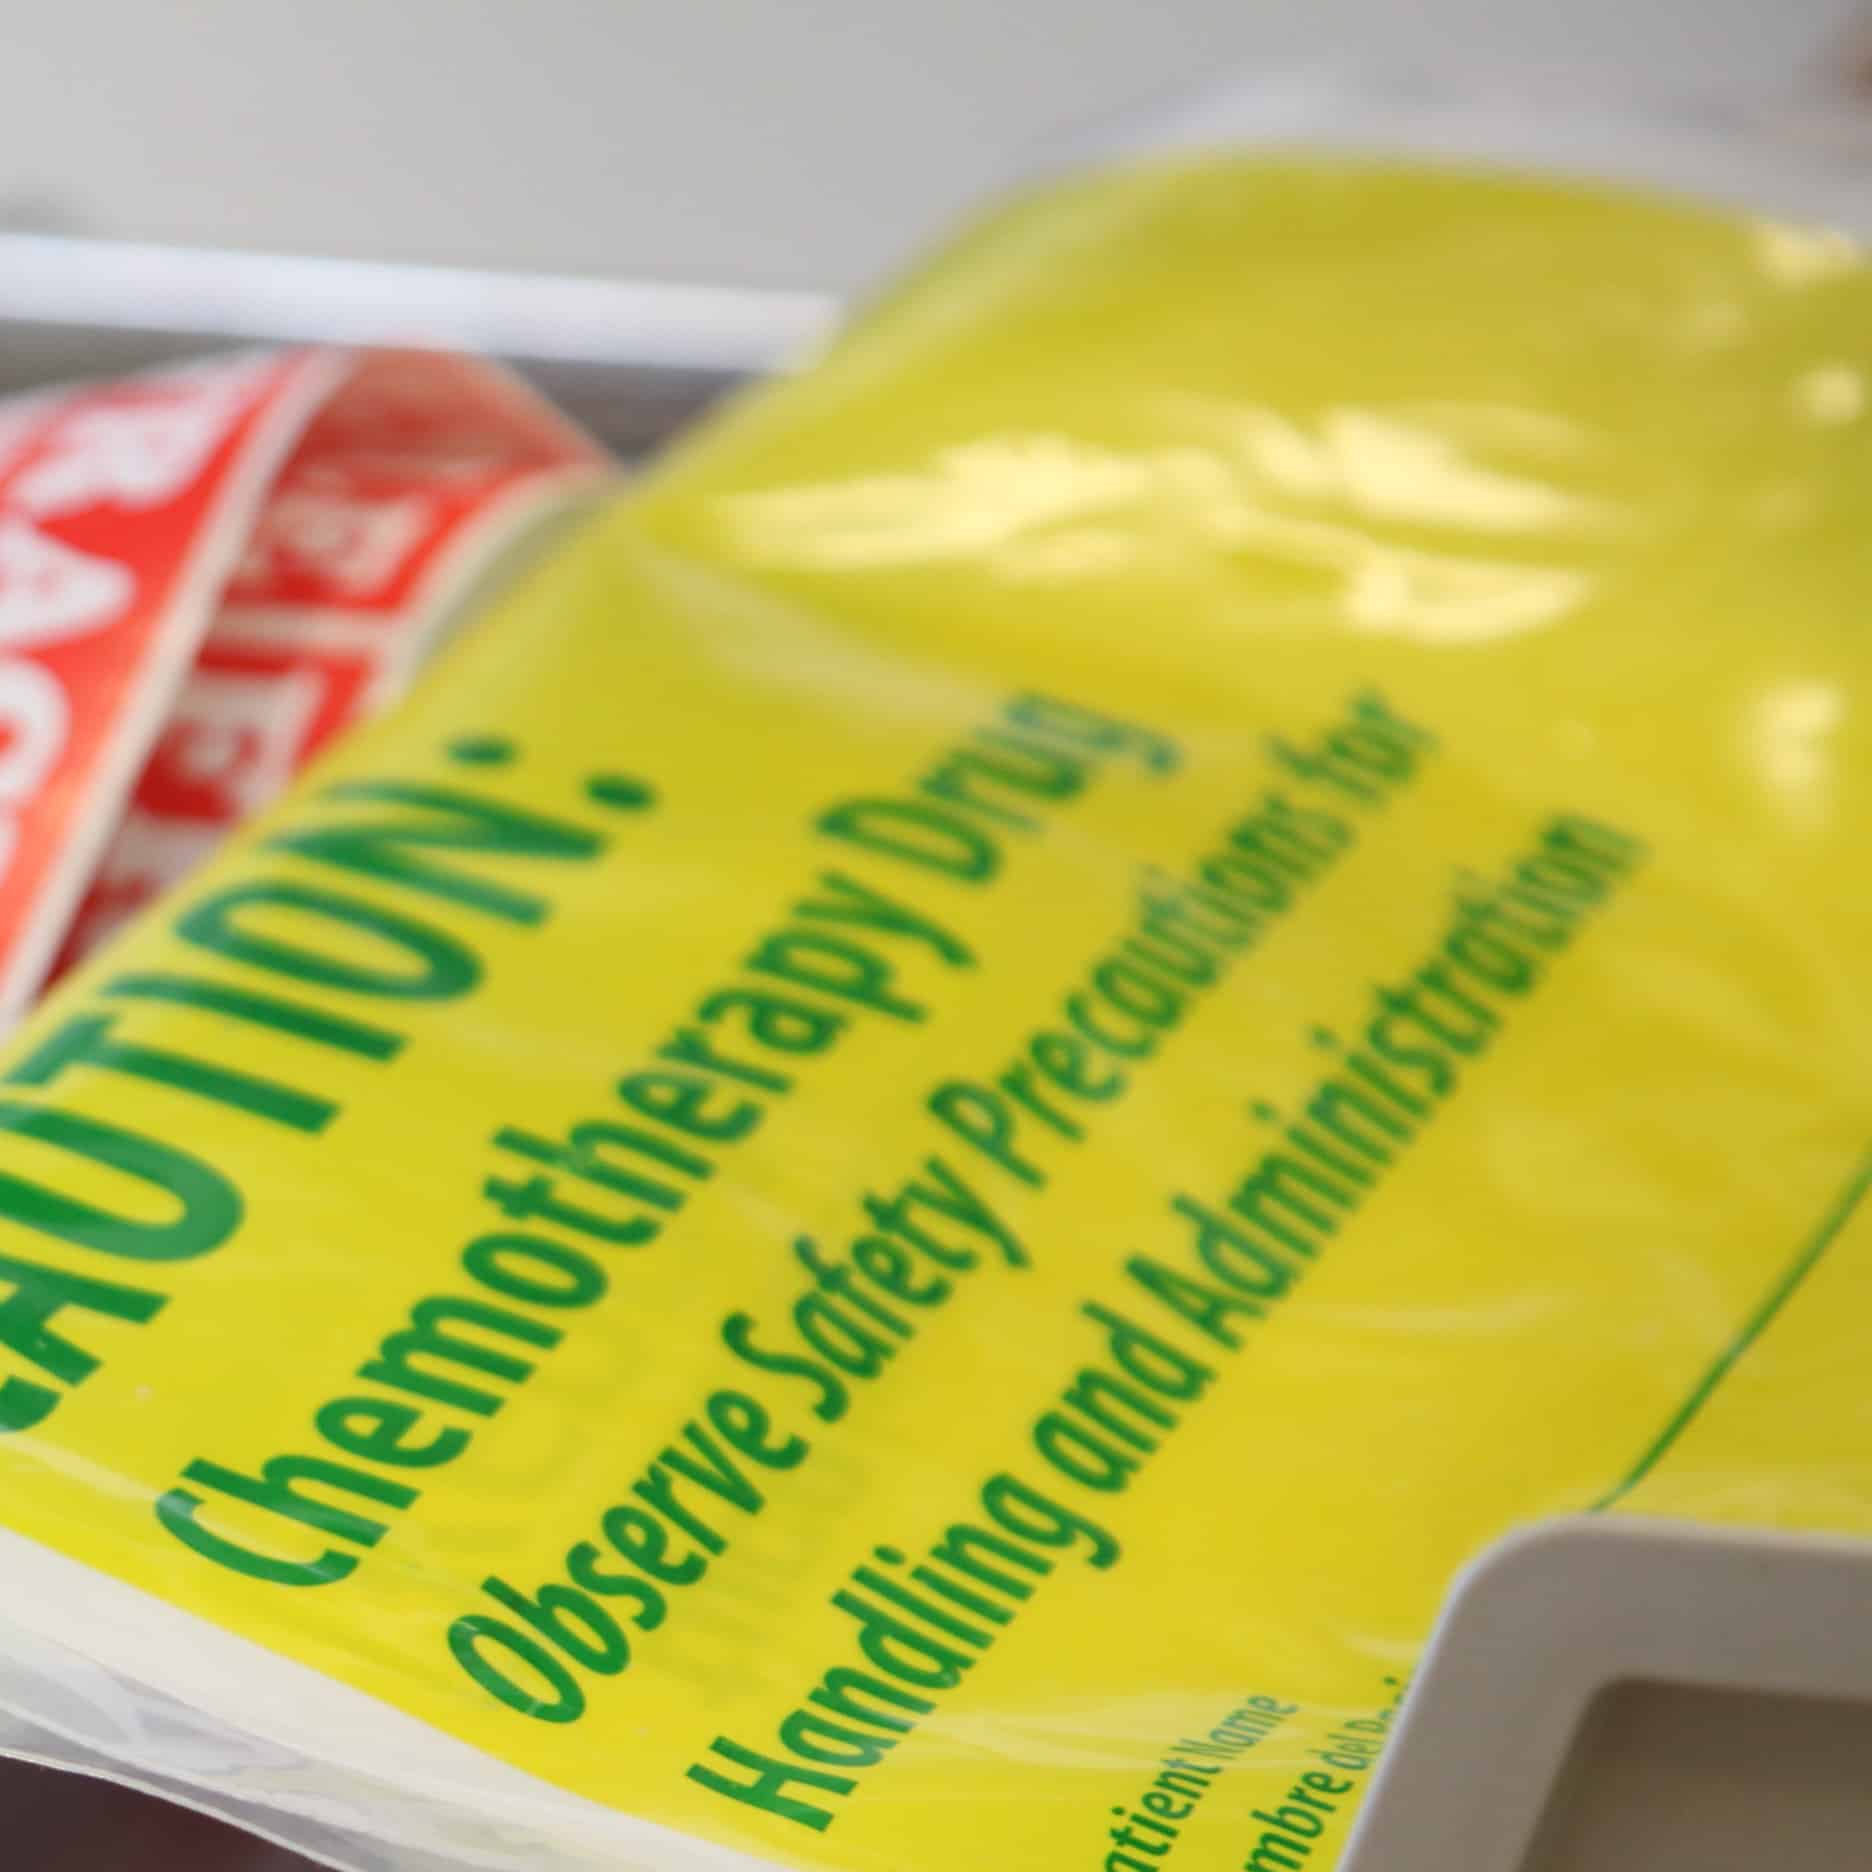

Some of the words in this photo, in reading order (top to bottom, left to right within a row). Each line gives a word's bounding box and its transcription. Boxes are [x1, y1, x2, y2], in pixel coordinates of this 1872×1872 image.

[154, 870, 978, 1587] Chemotherapy
[811, 691, 1182, 886] Drug
[445, 1389, 808, 1724] Observe
[720, 1156, 1031, 1423] Safety
[924, 792, 1358, 1192] Precautions
[1270, 687, 1439, 800] for
[1124, 814, 1651, 1353] Administration
[1031, 1299, 1219, 1498] and
[684, 1472, 1122, 1834] Handling
[1197, 1694, 1299, 1766] Name
